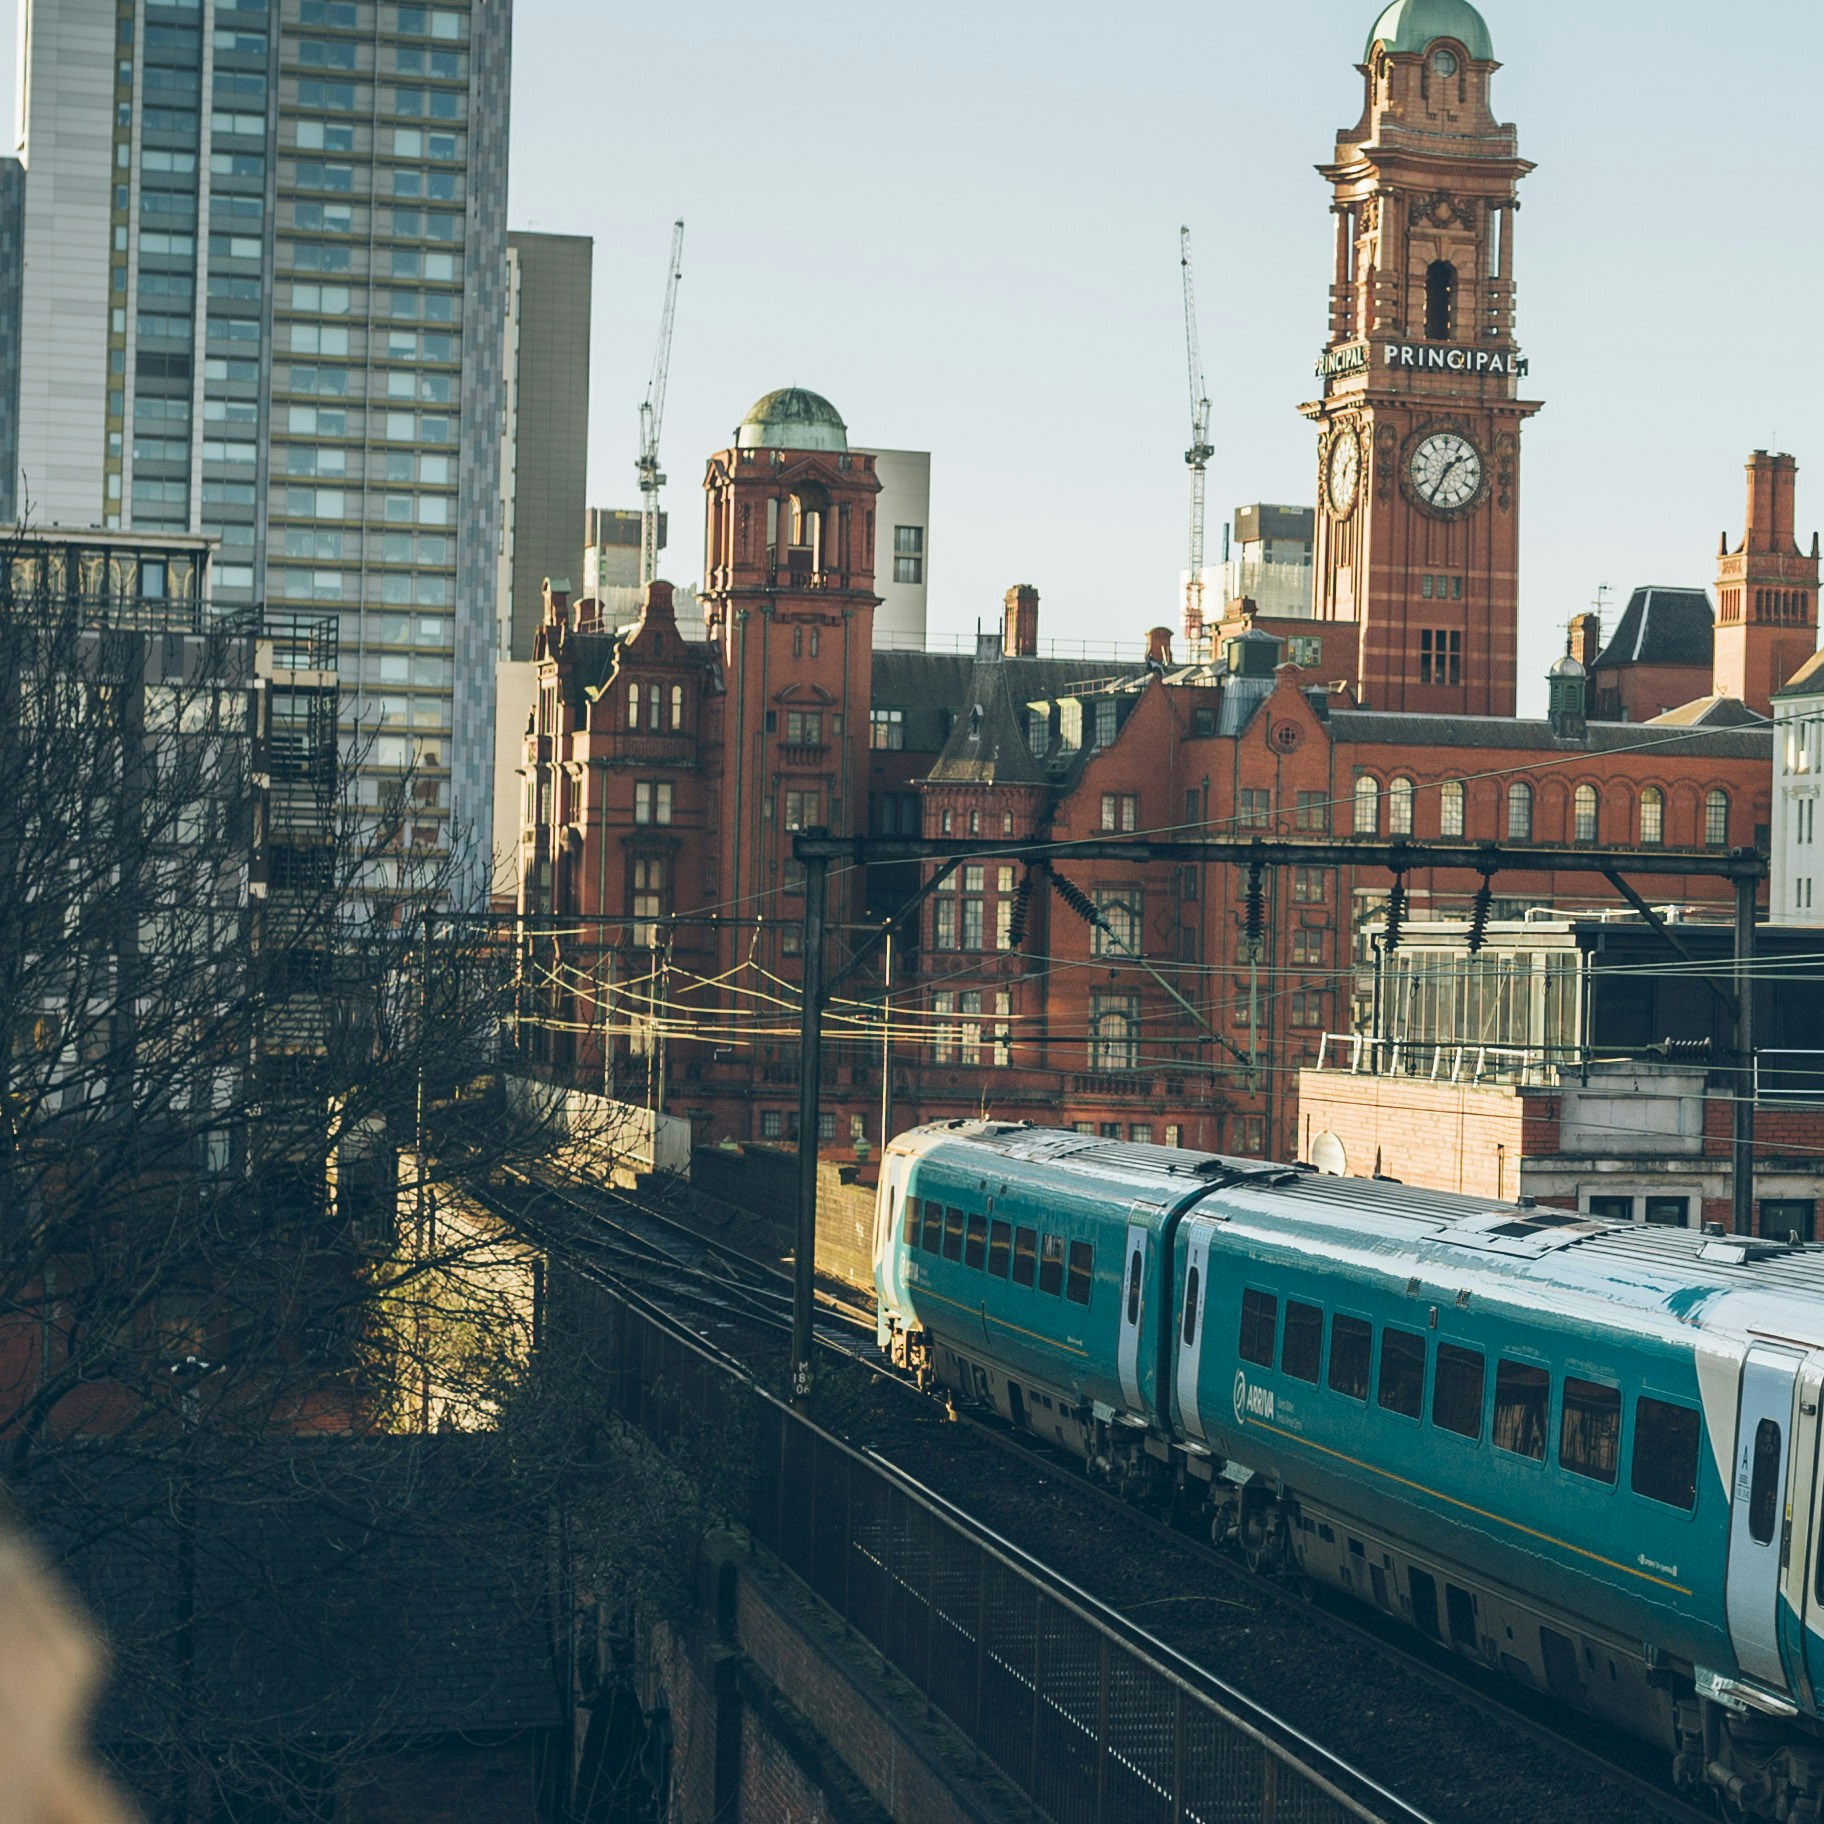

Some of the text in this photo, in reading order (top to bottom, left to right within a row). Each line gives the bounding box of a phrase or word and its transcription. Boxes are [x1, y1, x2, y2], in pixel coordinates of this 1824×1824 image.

[1315, 347, 1363, 375] PRINCIPAL
[1384, 344, 1518, 373] PRINCIPAL
[799, 1361, 808, 1372] M
[1246, 1384, 1274, 1420] ARRIVA
